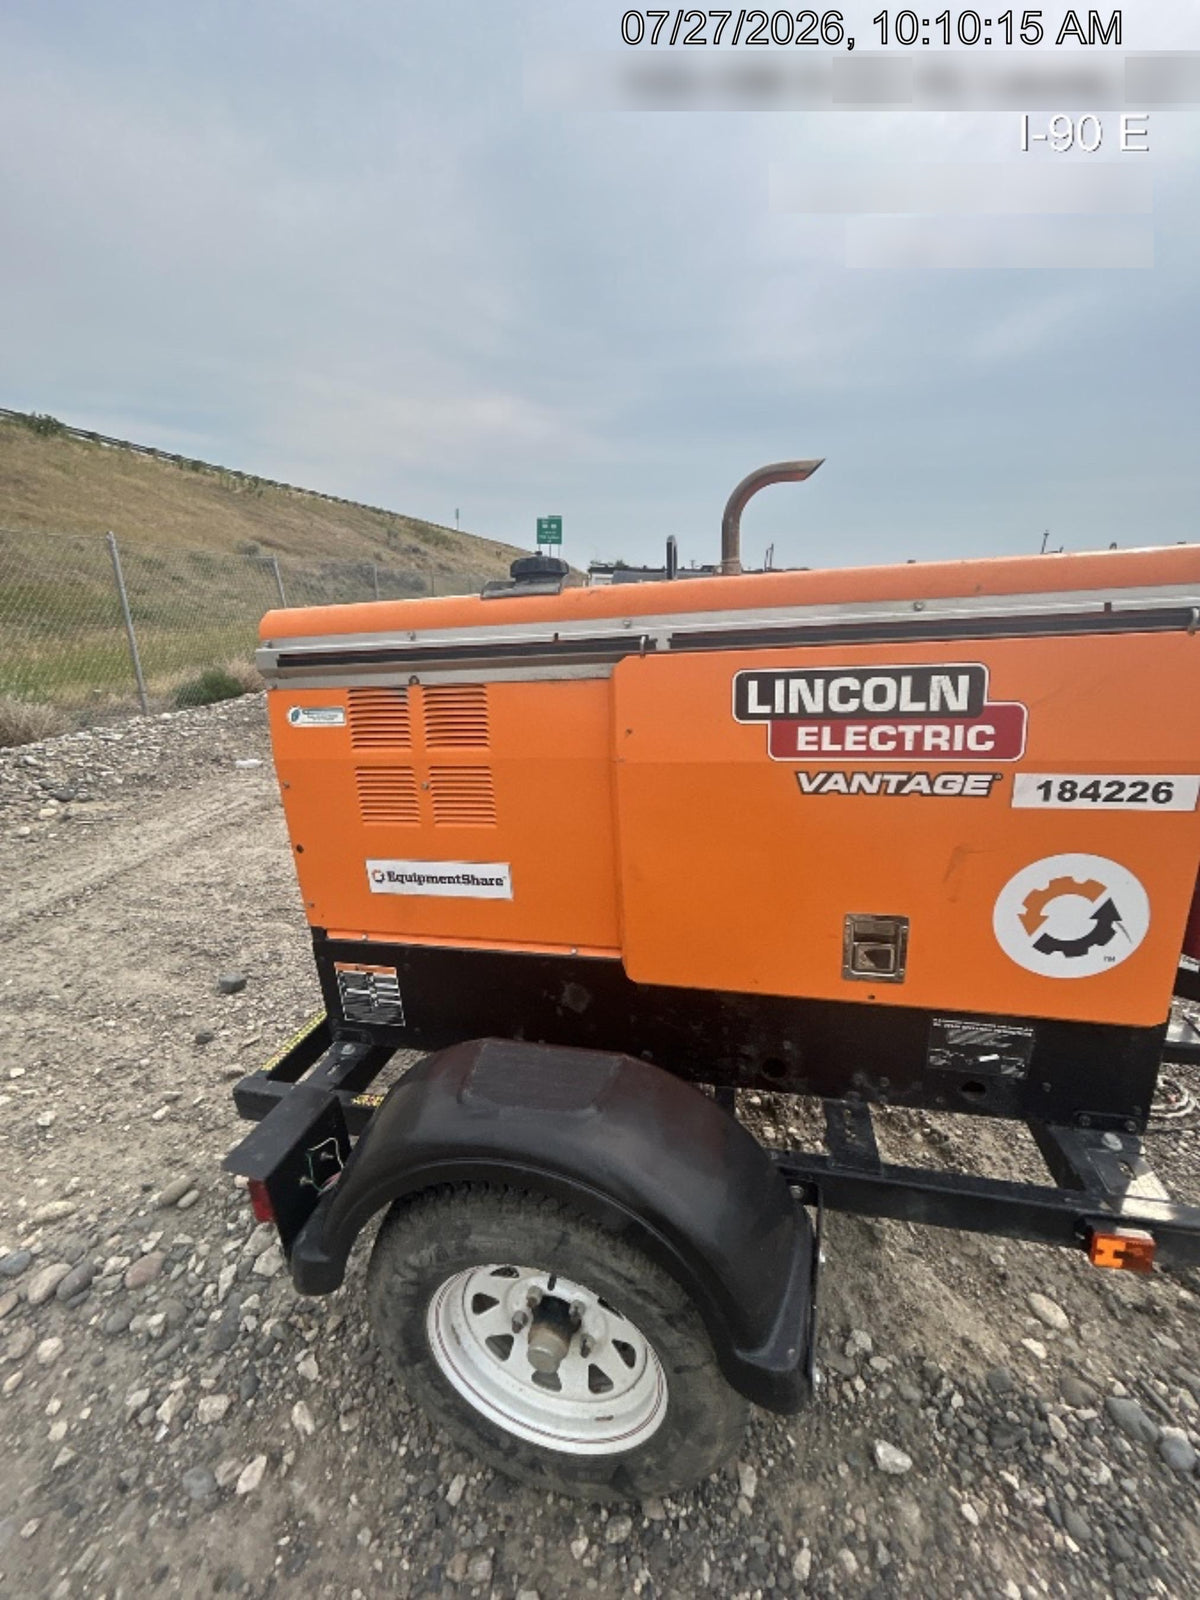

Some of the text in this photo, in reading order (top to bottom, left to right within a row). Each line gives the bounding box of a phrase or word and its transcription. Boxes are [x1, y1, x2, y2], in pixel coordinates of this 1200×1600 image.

[748, 675, 970, 714] LINCOLN
[796, 724, 996, 752] ELECTRIC
[796, 772, 994, 797] VANTAGE
[1036, 779, 1174, 805] 184226
[387, 871, 504, 887] EquipmentShare
